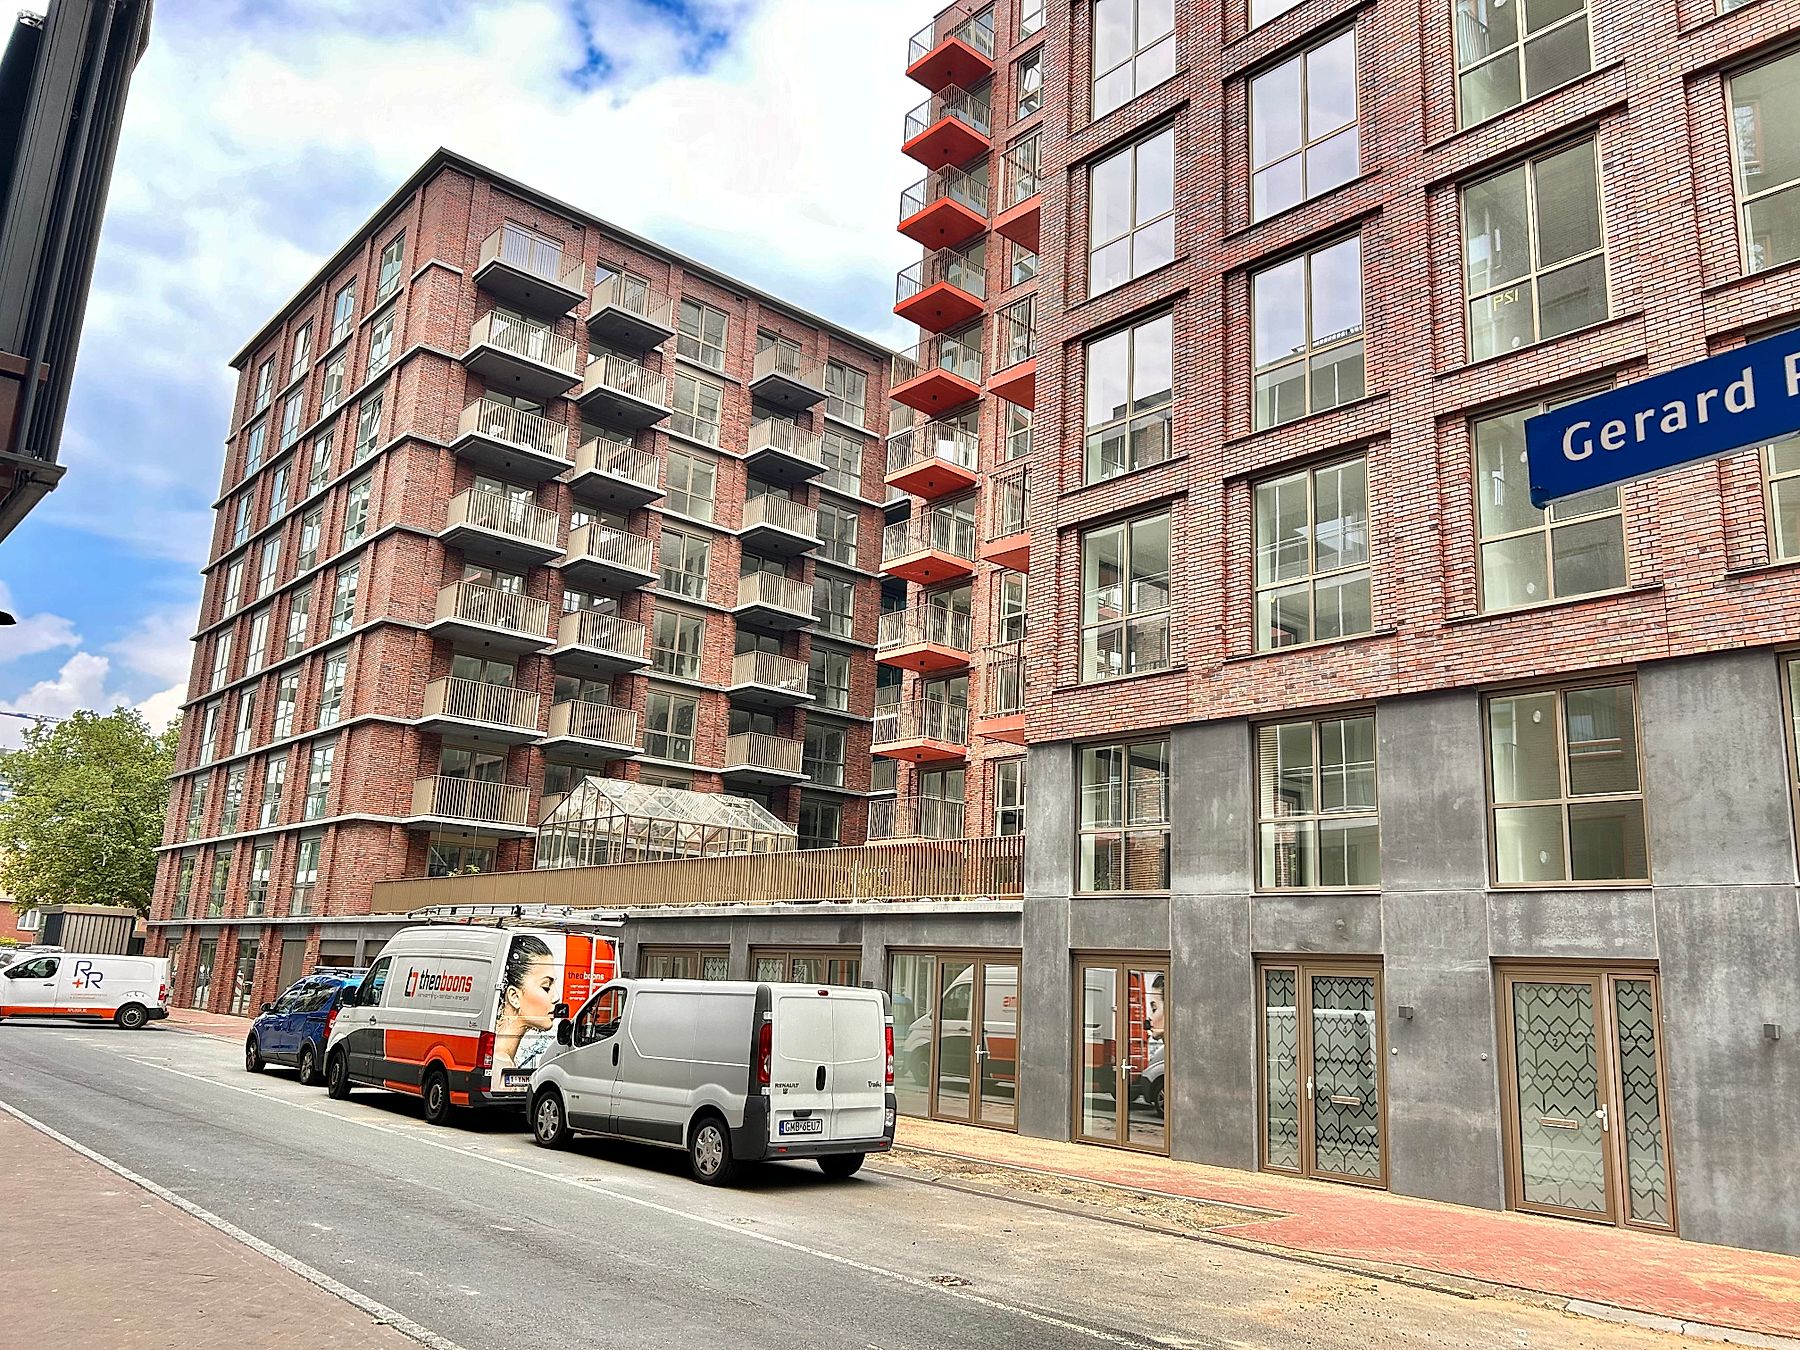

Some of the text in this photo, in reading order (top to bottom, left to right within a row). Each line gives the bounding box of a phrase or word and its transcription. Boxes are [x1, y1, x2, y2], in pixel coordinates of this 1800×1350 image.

[1561, 365, 1757, 462] Gerard
[419, 969, 473, 992] theoboons
[1552, 1038, 1558, 1047] 2
[785, 1119, 821, 1132] GMB 6EU7
